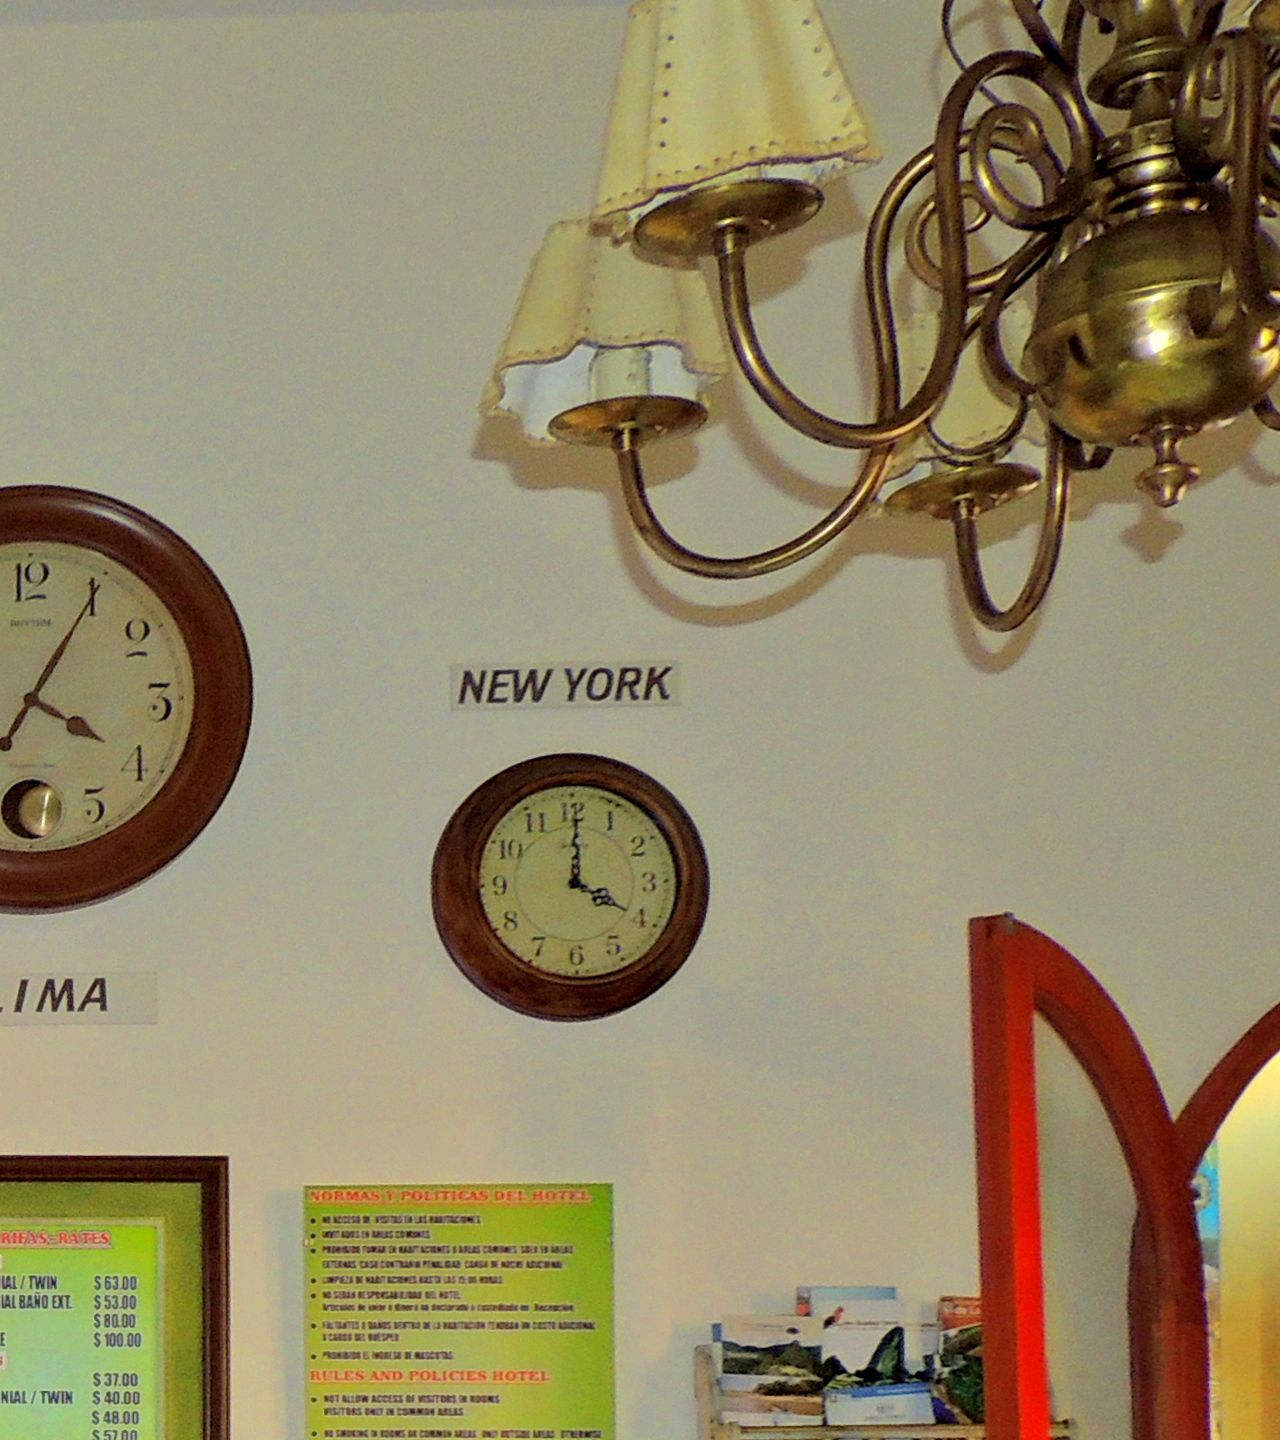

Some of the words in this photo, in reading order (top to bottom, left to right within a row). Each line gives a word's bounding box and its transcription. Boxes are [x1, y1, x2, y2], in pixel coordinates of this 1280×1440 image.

[15, 562, 49, 601] 12
[89, 578, 97, 616] 1
[125, 618, 150, 658] 2
[458, 669, 553, 703] NEW
[564, 667, 672, 702] YORK
[148, 682, 171, 721] 3
[121, 745, 148, 781] 4
[85, 788, 104, 823] 5
[561, 803, 583, 822] 12
[525, 813, 545, 832] 11
[606, 812, 614, 830] 1
[499, 840, 522, 859] 10
[631, 837, 645, 856] 2
[493, 876, 507, 895] 9
[643, 872, 656, 891] 3
[504, 912, 518, 930] 8
[633, 909, 646, 928] 4
[532, 937, 546, 956] 7
[606, 936, 620, 955] 5
[570, 946, 583, 965] 6
[29, 1276, 57, 1290] TWIN
[104, 1276, 136, 1290] 63.00
[19, 1292, 48, 1309] BAÑO
[52, 1295, 72, 1309] EXT.
[104, 1296, 136, 1309] 53.00
[104, 1314, 135, 1328] 80.00
[105, 1333, 141, 1347] 100.00
[104, 1373, 138, 1387] 37.00
[310, 1371, 364, 1381] RULES
[370, 1371, 403, 1381] AND
[409, 1371, 487, 1381] POLICIES
[492, 1371, 550, 1382] HOTEL
[40, 1391, 73, 1404] TWIN
[104, 1392, 140, 1405] 40.00
[103, 1411, 139, 1424] 48.00
